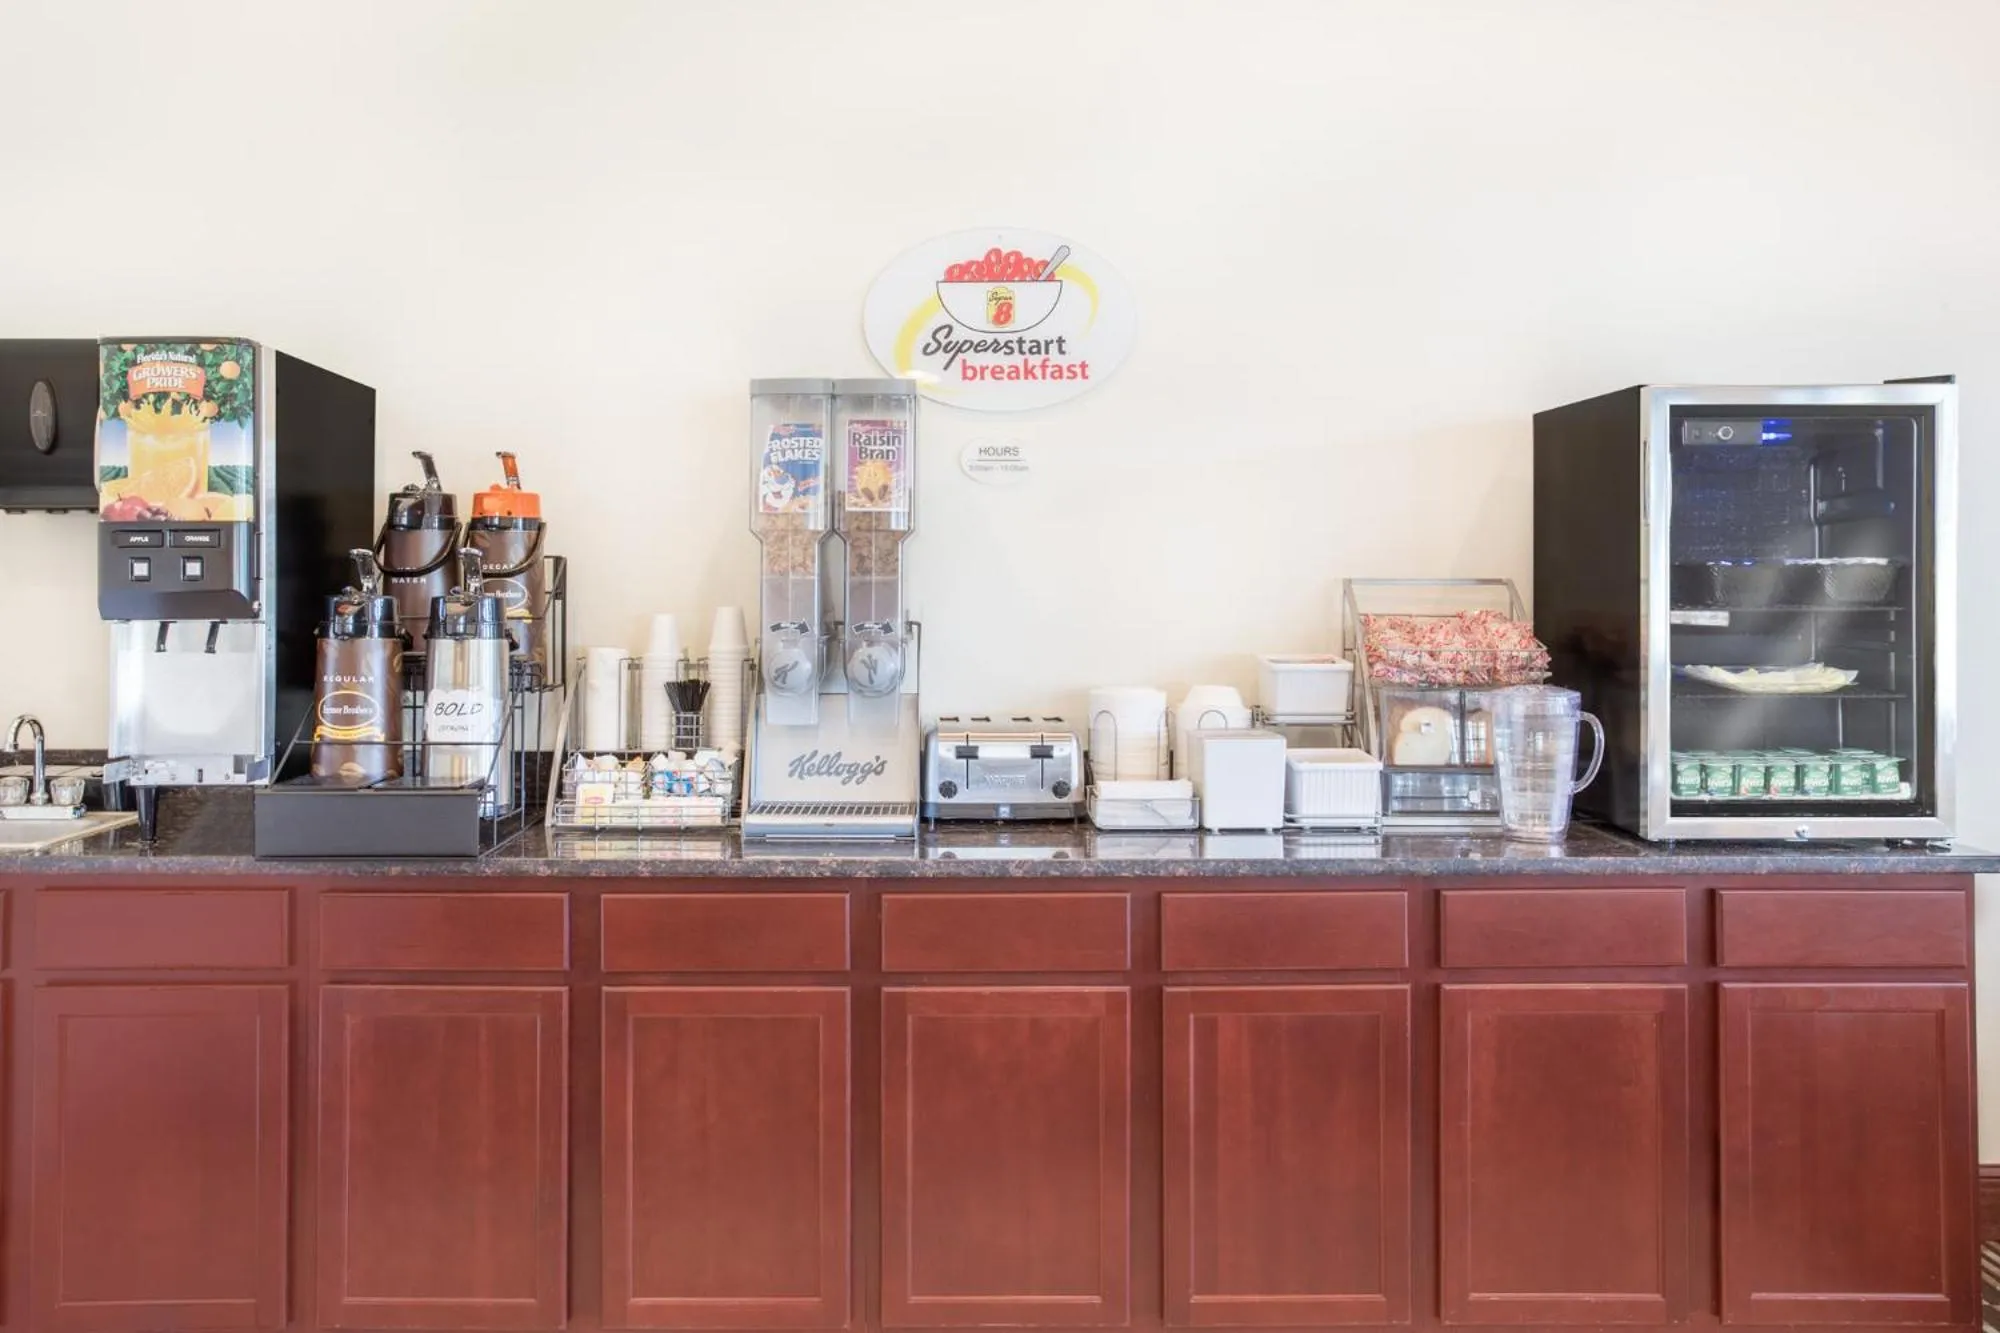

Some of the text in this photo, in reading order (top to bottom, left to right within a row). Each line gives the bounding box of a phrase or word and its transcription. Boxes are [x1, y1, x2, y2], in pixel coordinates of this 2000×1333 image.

[988, 291, 1013, 306] Super
[992, 302, 1014, 326] 8
[922, 324, 1067, 371] Superstart
[961, 358, 1089, 381] breakfast
[147, 376, 186, 389] PRIDE
[852, 431, 901, 446] Raisin
[770, 448, 821, 464] FLAKES
[858, 446, 897, 460] Bran
[979, 446, 1020, 457] HOURS
[391, 576, 428, 585] WATER
[323, 675, 375, 683] REGULAR
[434, 702, 484, 716] BOLD
[787, 749, 888, 786] Kellogg's
